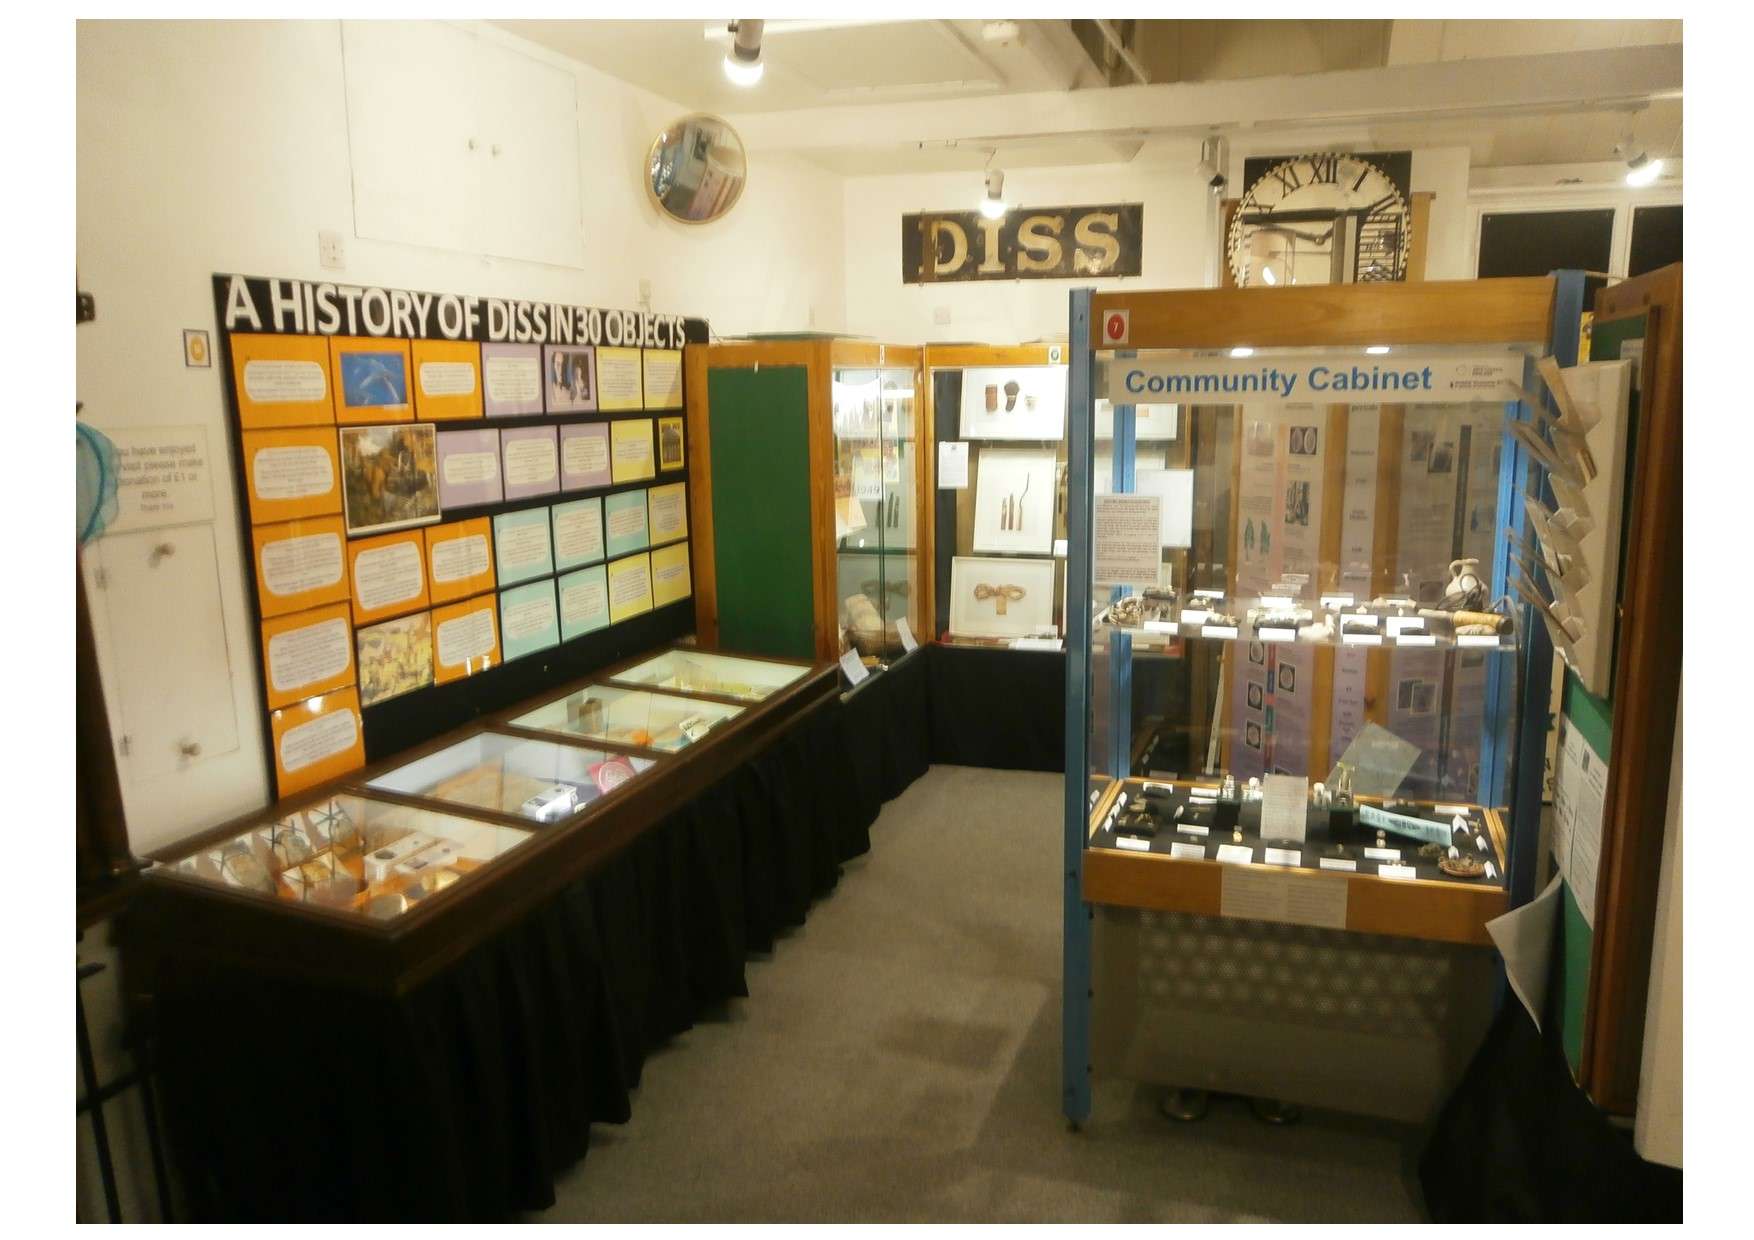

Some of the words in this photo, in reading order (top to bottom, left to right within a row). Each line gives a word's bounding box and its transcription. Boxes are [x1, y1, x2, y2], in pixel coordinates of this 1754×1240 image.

[1310, 157, 1340, 185] XII
[917, 212, 1121, 276] DISS
[225, 274, 262, 330] A
[269, 277, 433, 339] HISTORY
[437, 293, 481, 341] OF
[487, 297, 547, 344] DISS
[548, 302, 572, 344] IN
[574, 306, 601, 346] 30
[604, 309, 686, 350] OBJECTS
[1125, 367, 1297, 397] Community
[1308, 365, 1433, 392] Cabinet
